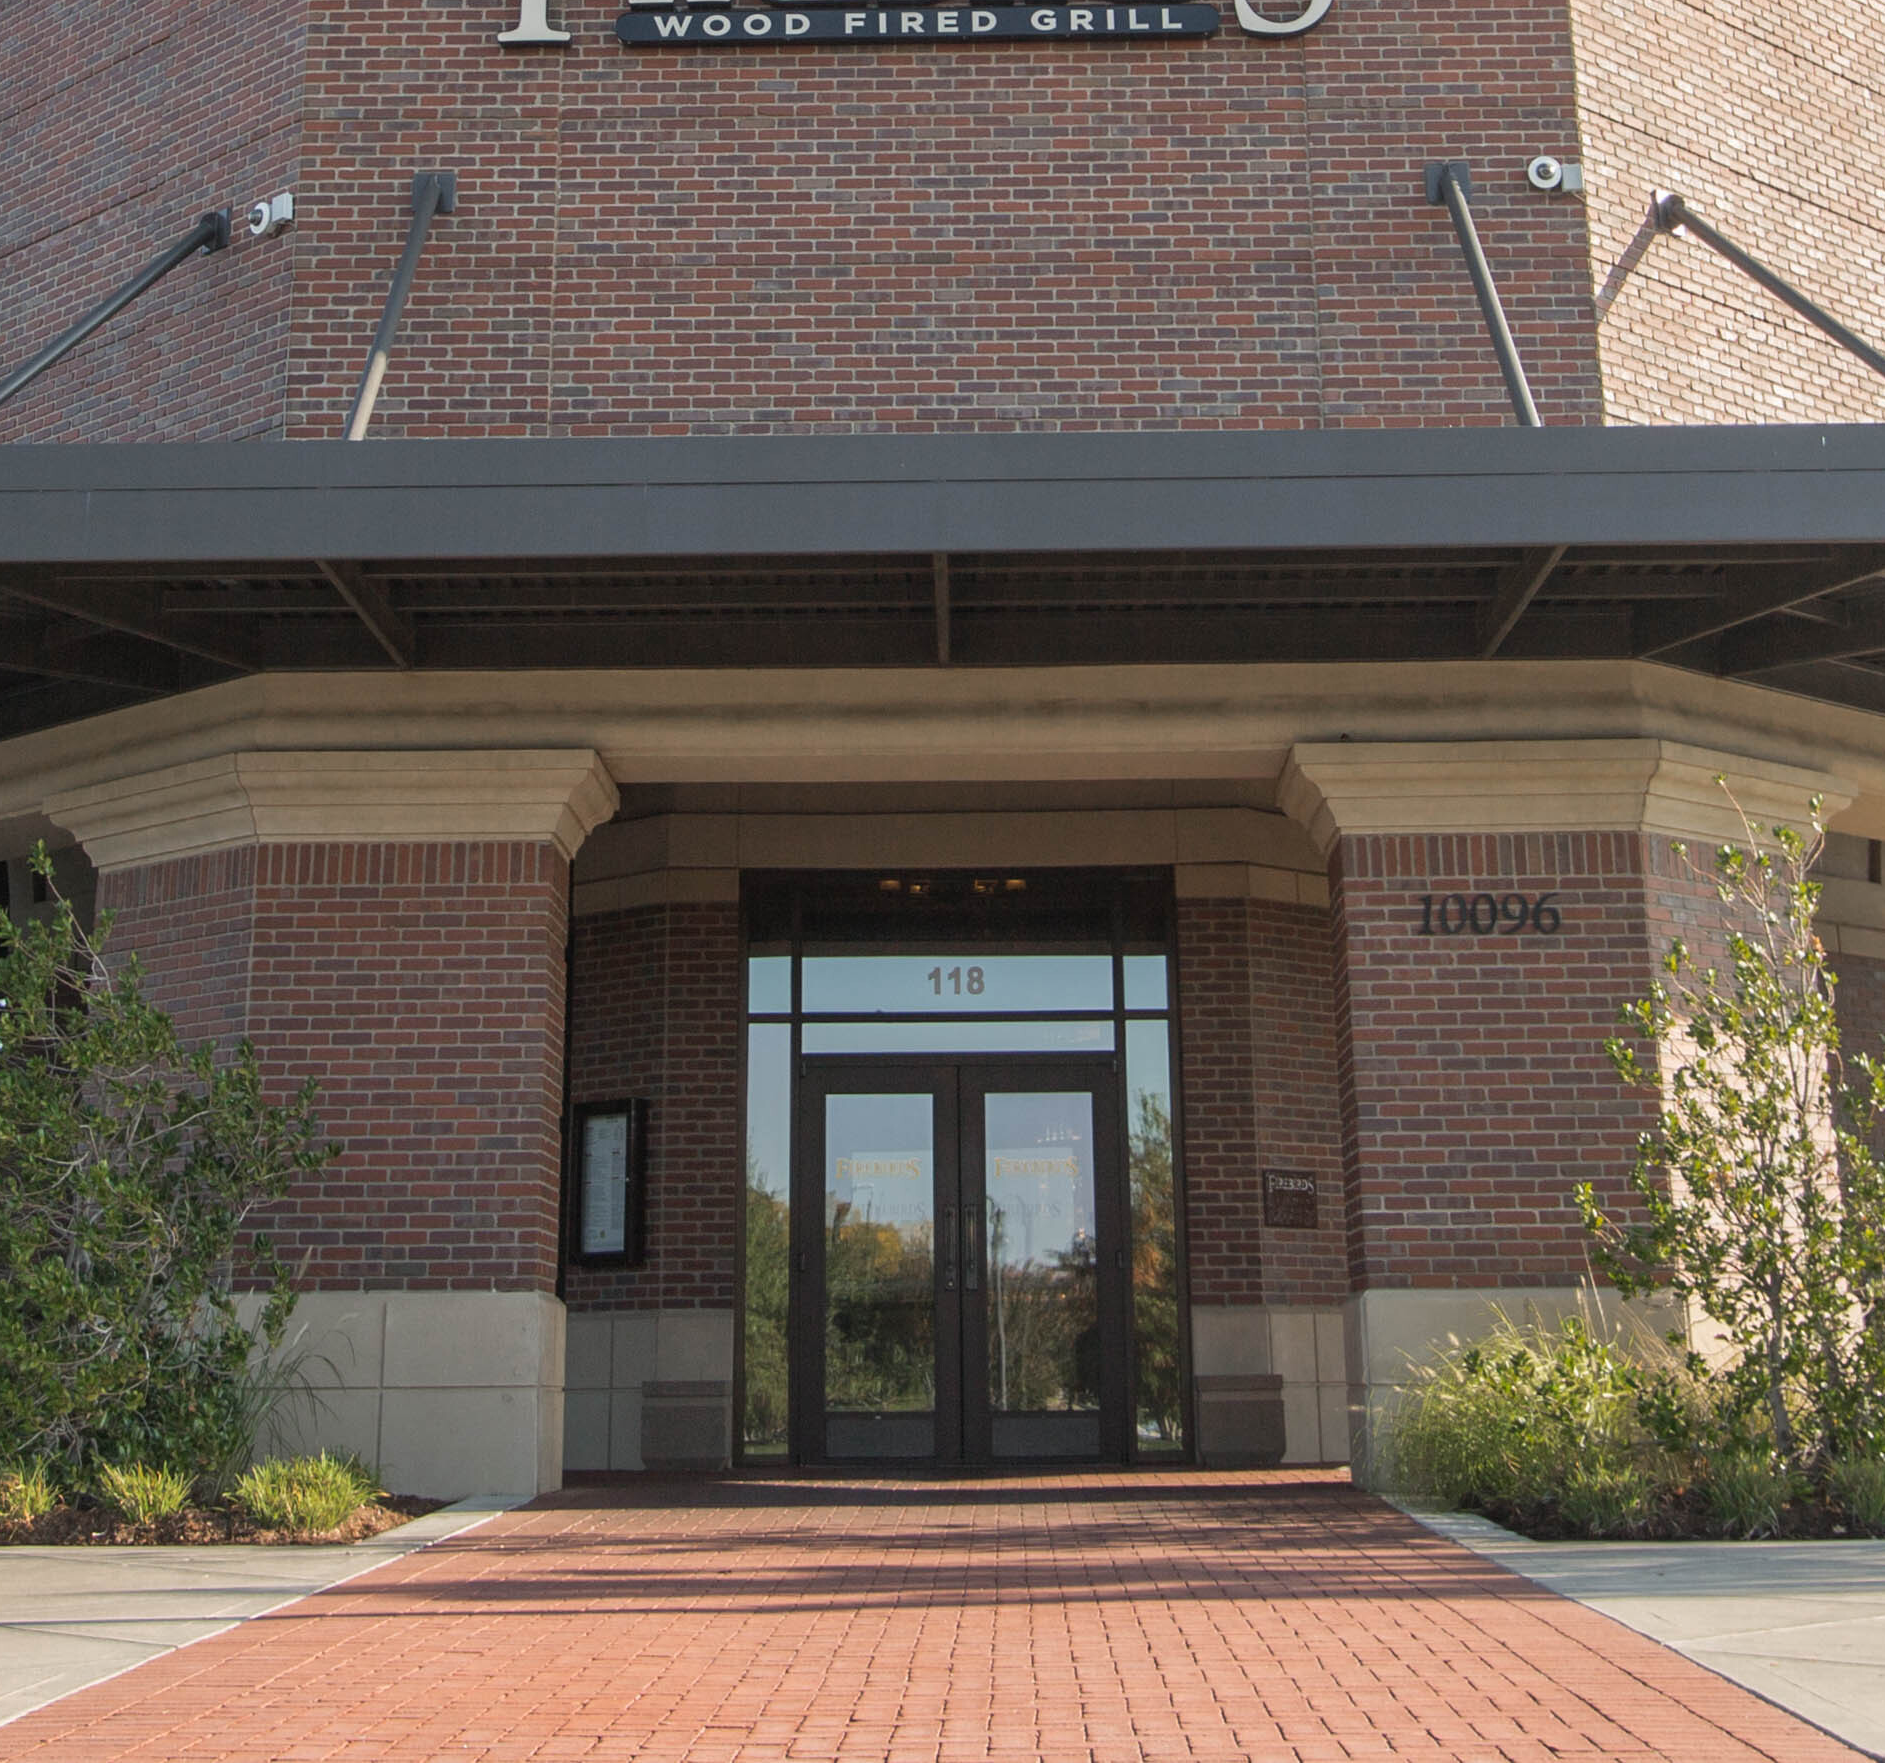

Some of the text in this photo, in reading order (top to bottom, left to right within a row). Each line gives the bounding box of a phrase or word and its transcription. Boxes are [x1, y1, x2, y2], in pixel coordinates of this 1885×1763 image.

[653, 8, 1182, 37] WOOD FIRED GRILL
[1418, 893, 1561, 935] 10096
[927, 966, 985, 995] 118
